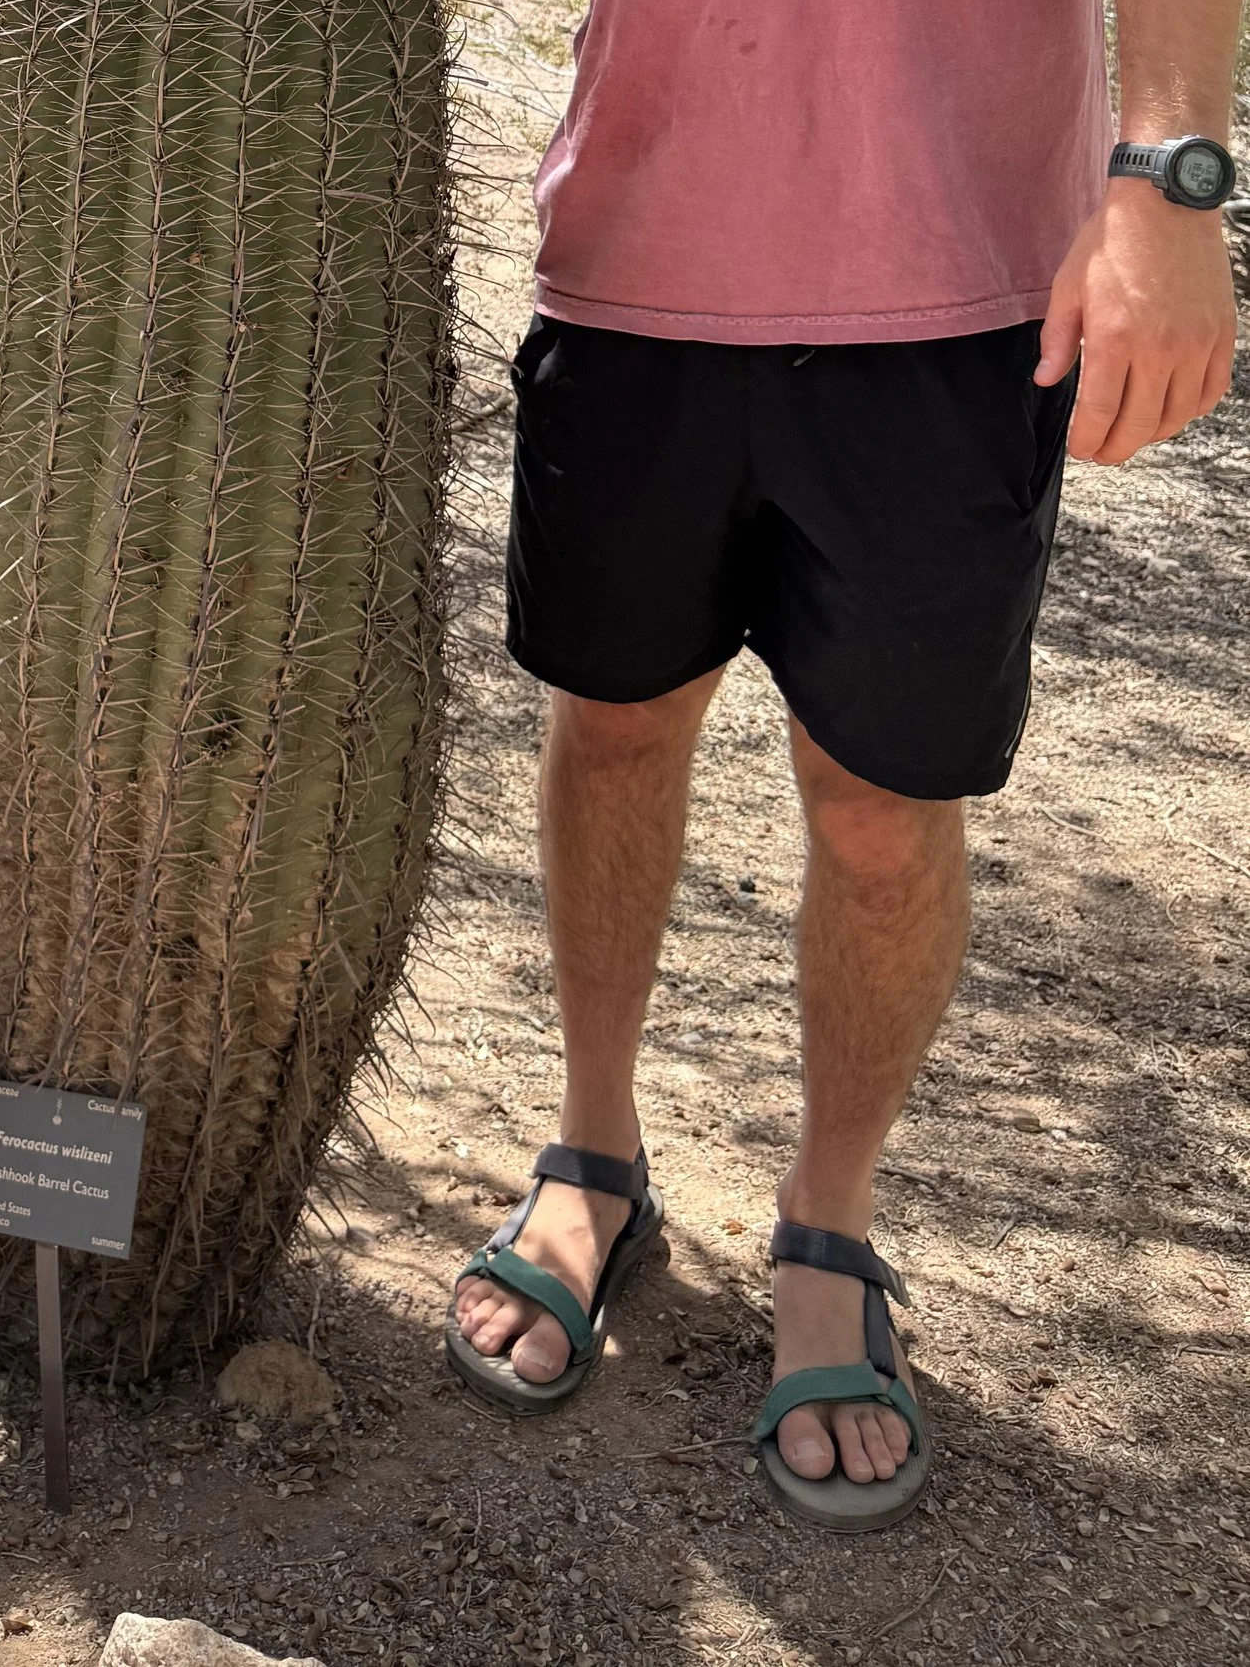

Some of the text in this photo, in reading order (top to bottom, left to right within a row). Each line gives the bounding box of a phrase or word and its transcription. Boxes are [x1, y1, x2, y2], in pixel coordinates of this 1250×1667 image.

[88, 1099, 143, 1121] Cactus amily
[61, 1144, 113, 1164] wislizeni
[38, 1174, 70, 1192] Barrel
[72, 1181, 110, 1199] Cactus
[8, 1201, 31, 1216] States
[91, 1236, 126, 1250] summer
